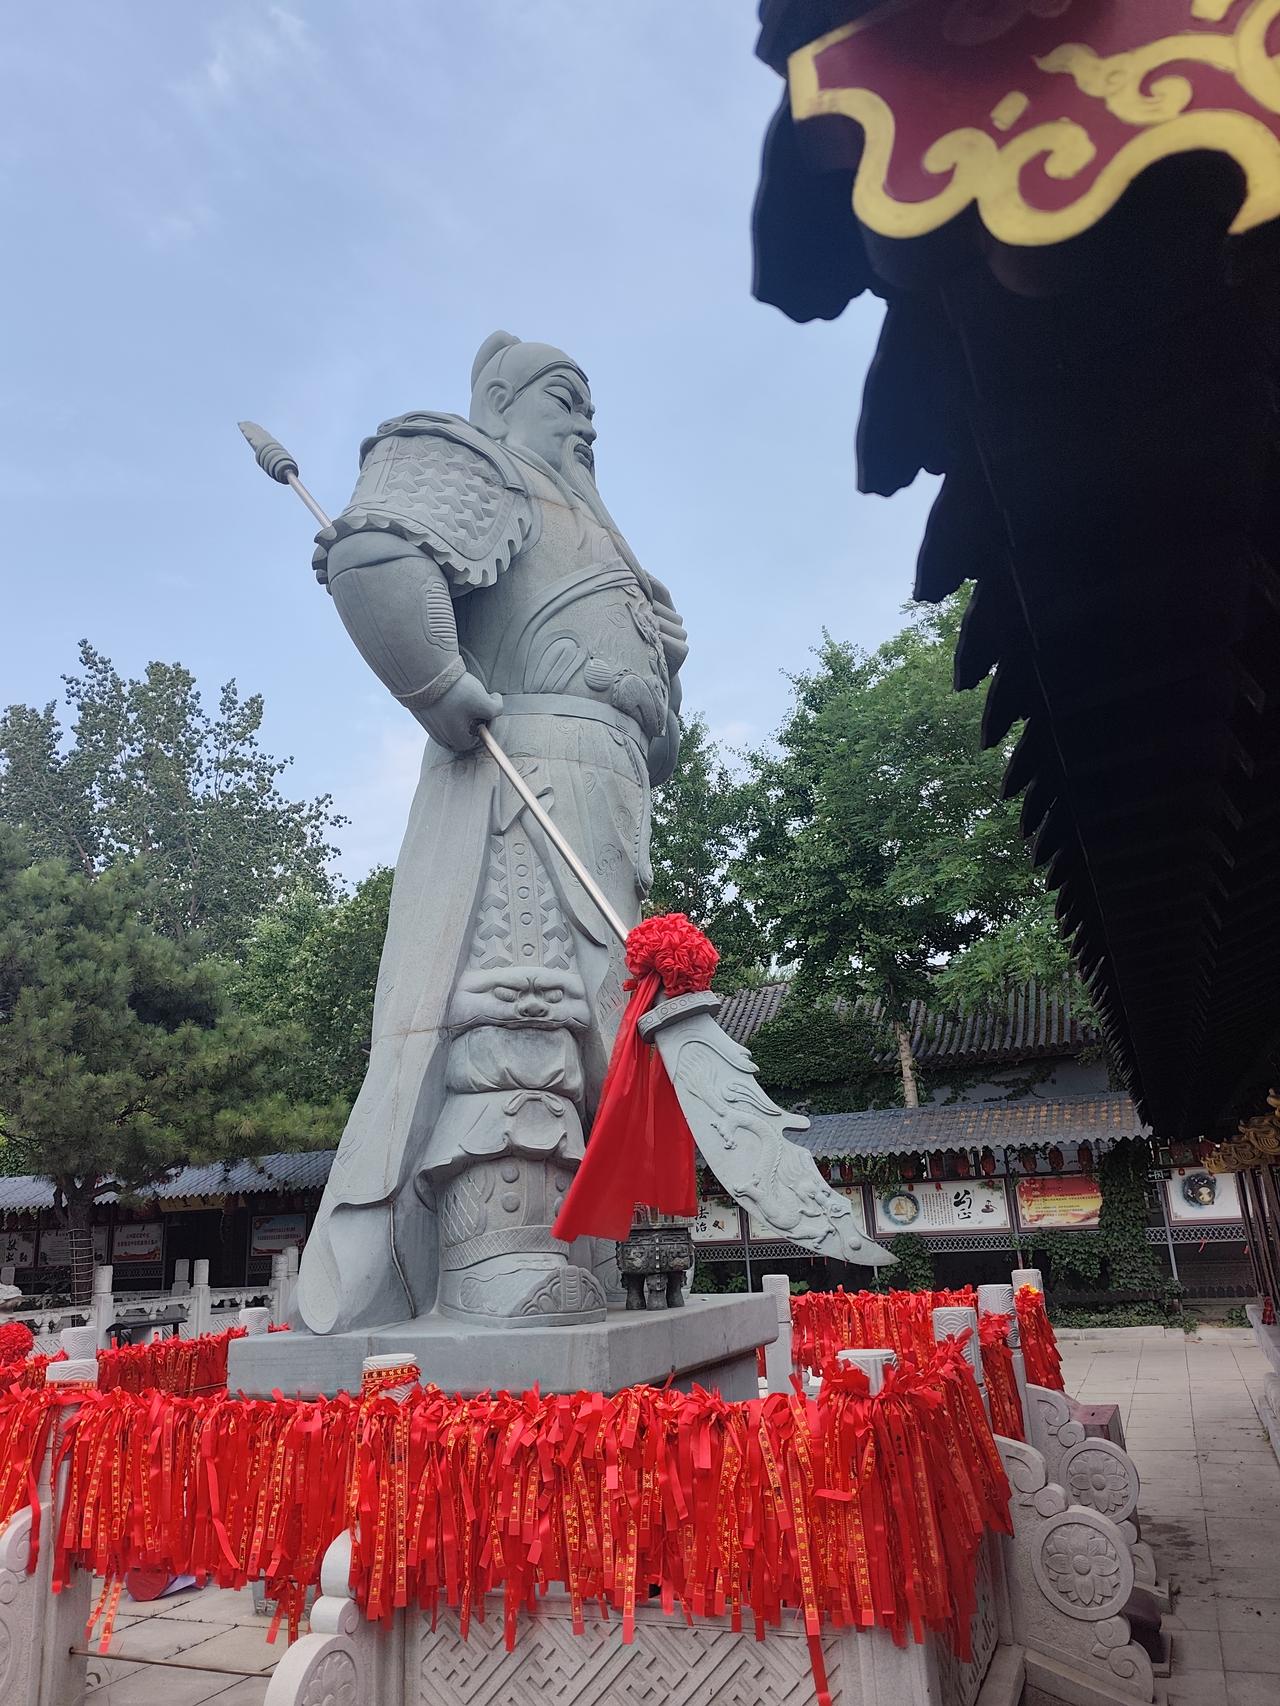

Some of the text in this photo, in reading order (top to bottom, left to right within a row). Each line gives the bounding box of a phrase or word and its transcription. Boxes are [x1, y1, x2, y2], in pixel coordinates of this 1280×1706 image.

[694, 1206, 709, 1233] 法治
[801, 1555, 813, 1594] 工作顺利
